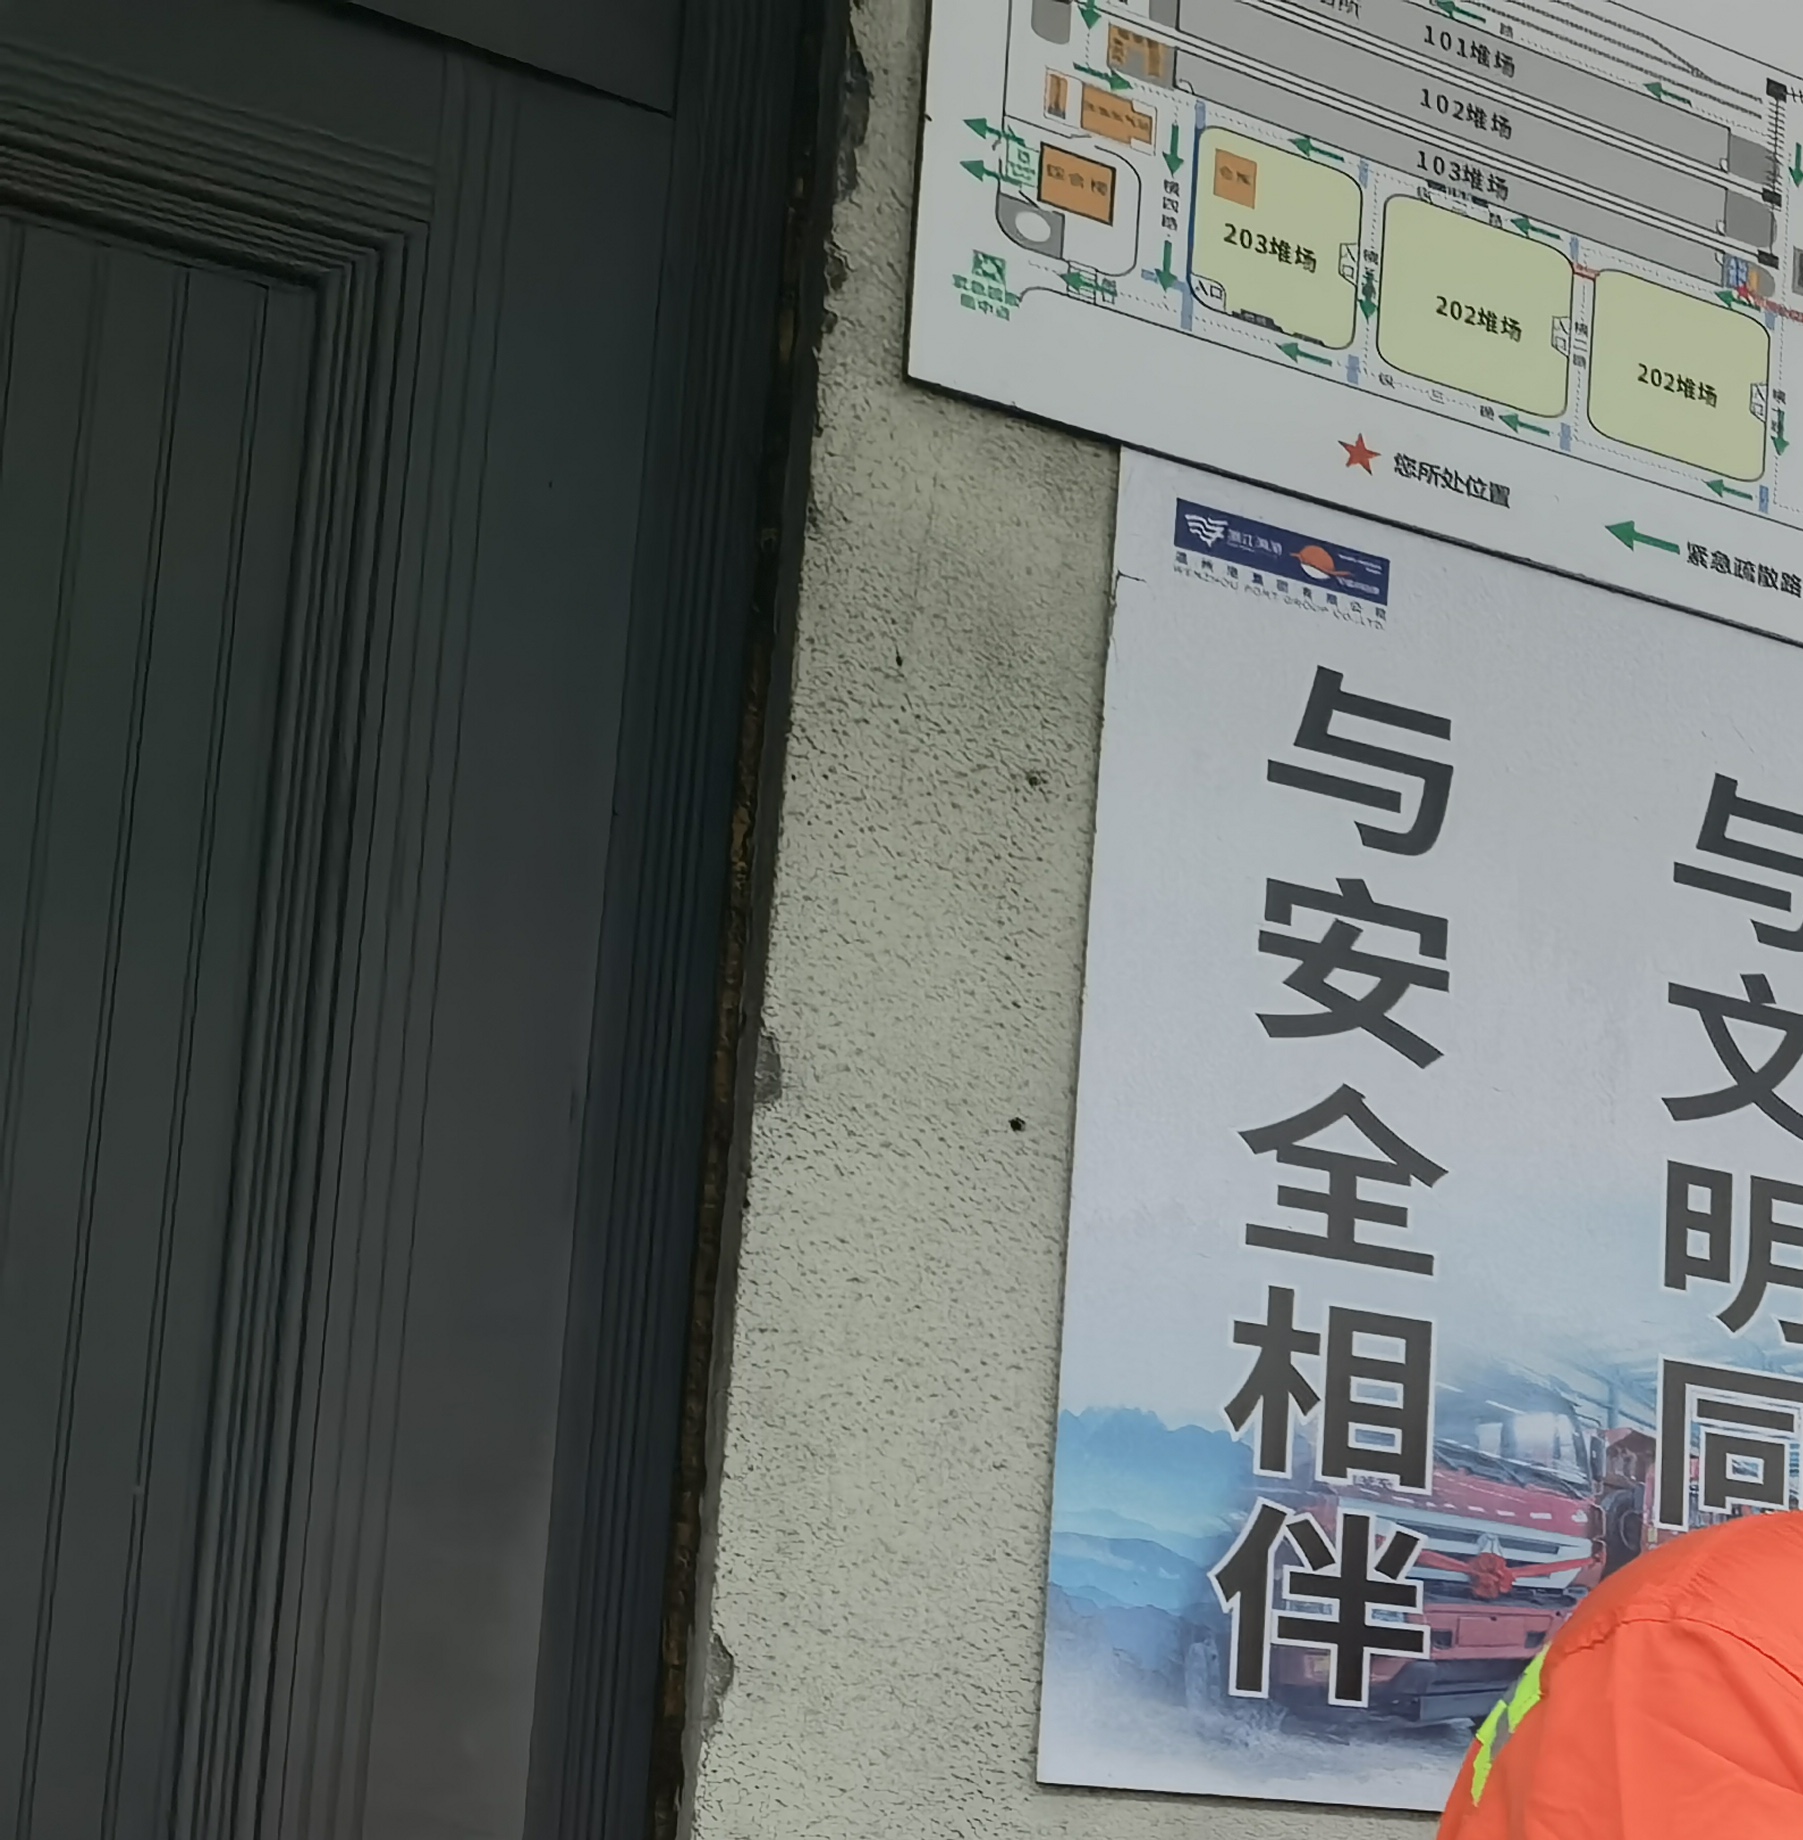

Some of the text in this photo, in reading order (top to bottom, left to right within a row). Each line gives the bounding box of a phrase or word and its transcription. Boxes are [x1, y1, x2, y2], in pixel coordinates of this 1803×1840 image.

[1424, 25, 1516, 78] 101堆场
[1420, 88, 1512, 139] 102堆场
[1417, 150, 1508, 201] 103堆场
[1223, 222, 1317, 273] 203堆场
[1436, 295, 1522, 342] 202堆场
[1637, 362, 1718, 408] 202堆场
[1393, 452, 1511, 509] 您所处位置
[1212, 665, 1455, 1706] 与安全相伴
